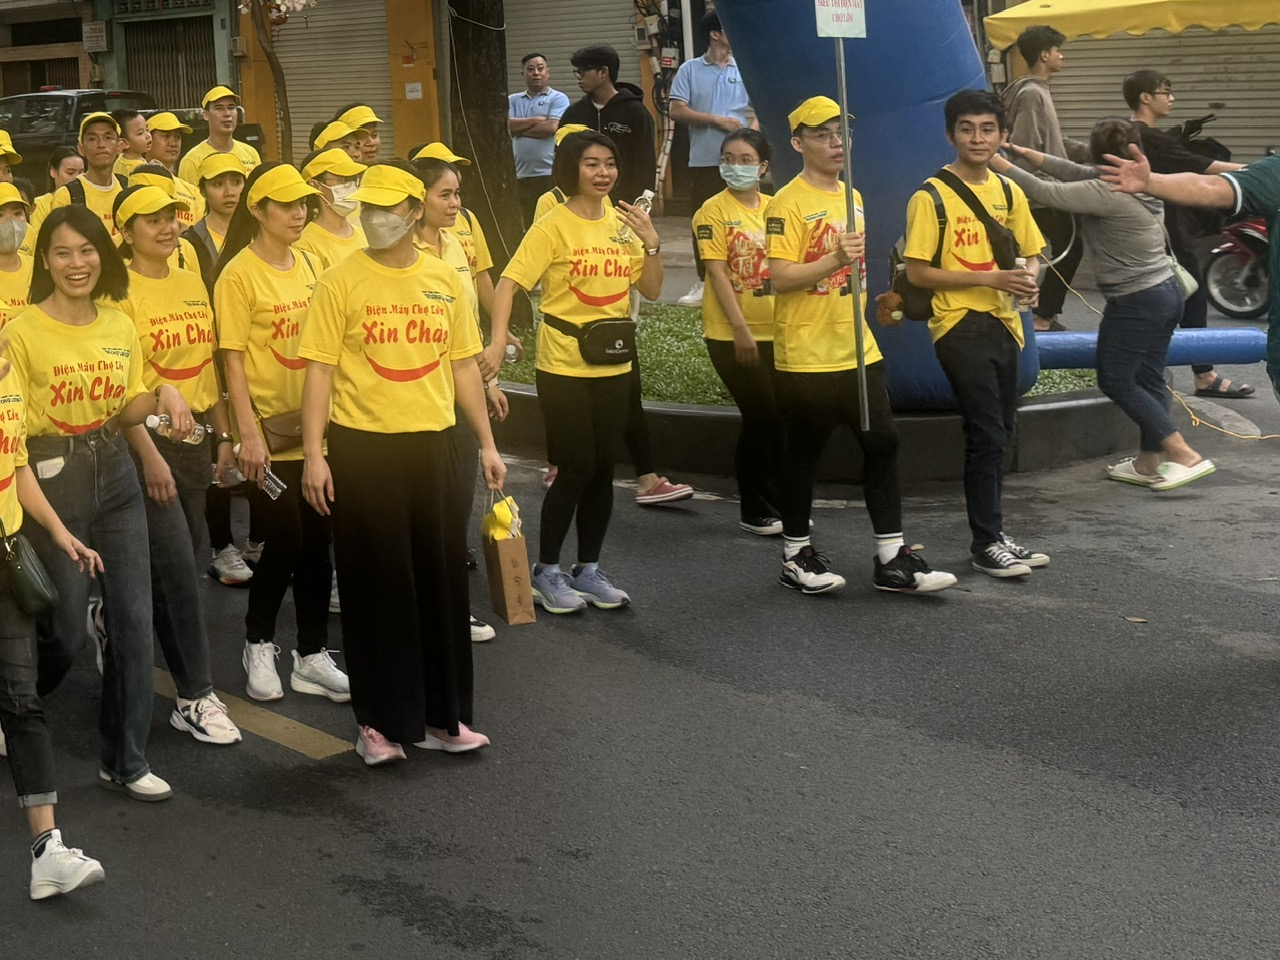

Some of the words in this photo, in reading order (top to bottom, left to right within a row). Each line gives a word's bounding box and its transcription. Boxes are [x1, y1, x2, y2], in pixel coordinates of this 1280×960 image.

[954, 228, 979, 247] Xin
[570, 258, 599, 278] Xin
[273, 303, 291, 315] Điện
[292, 299, 308, 313] Máy
[366, 304, 388, 316] Điện
[389, 304, 409, 317] Máy
[412, 303, 429, 316] Chợ
[149, 315, 168, 327] Điện
[271, 318, 300, 340] Xin
[150, 328, 182, 353] Xin
[362, 320, 399, 345] Xin
[53, 364, 76, 378] Điện
[77, 362, 95, 374] Máy
[97, 360, 114, 372] Chợ
[50, 379, 85, 408] Xin
